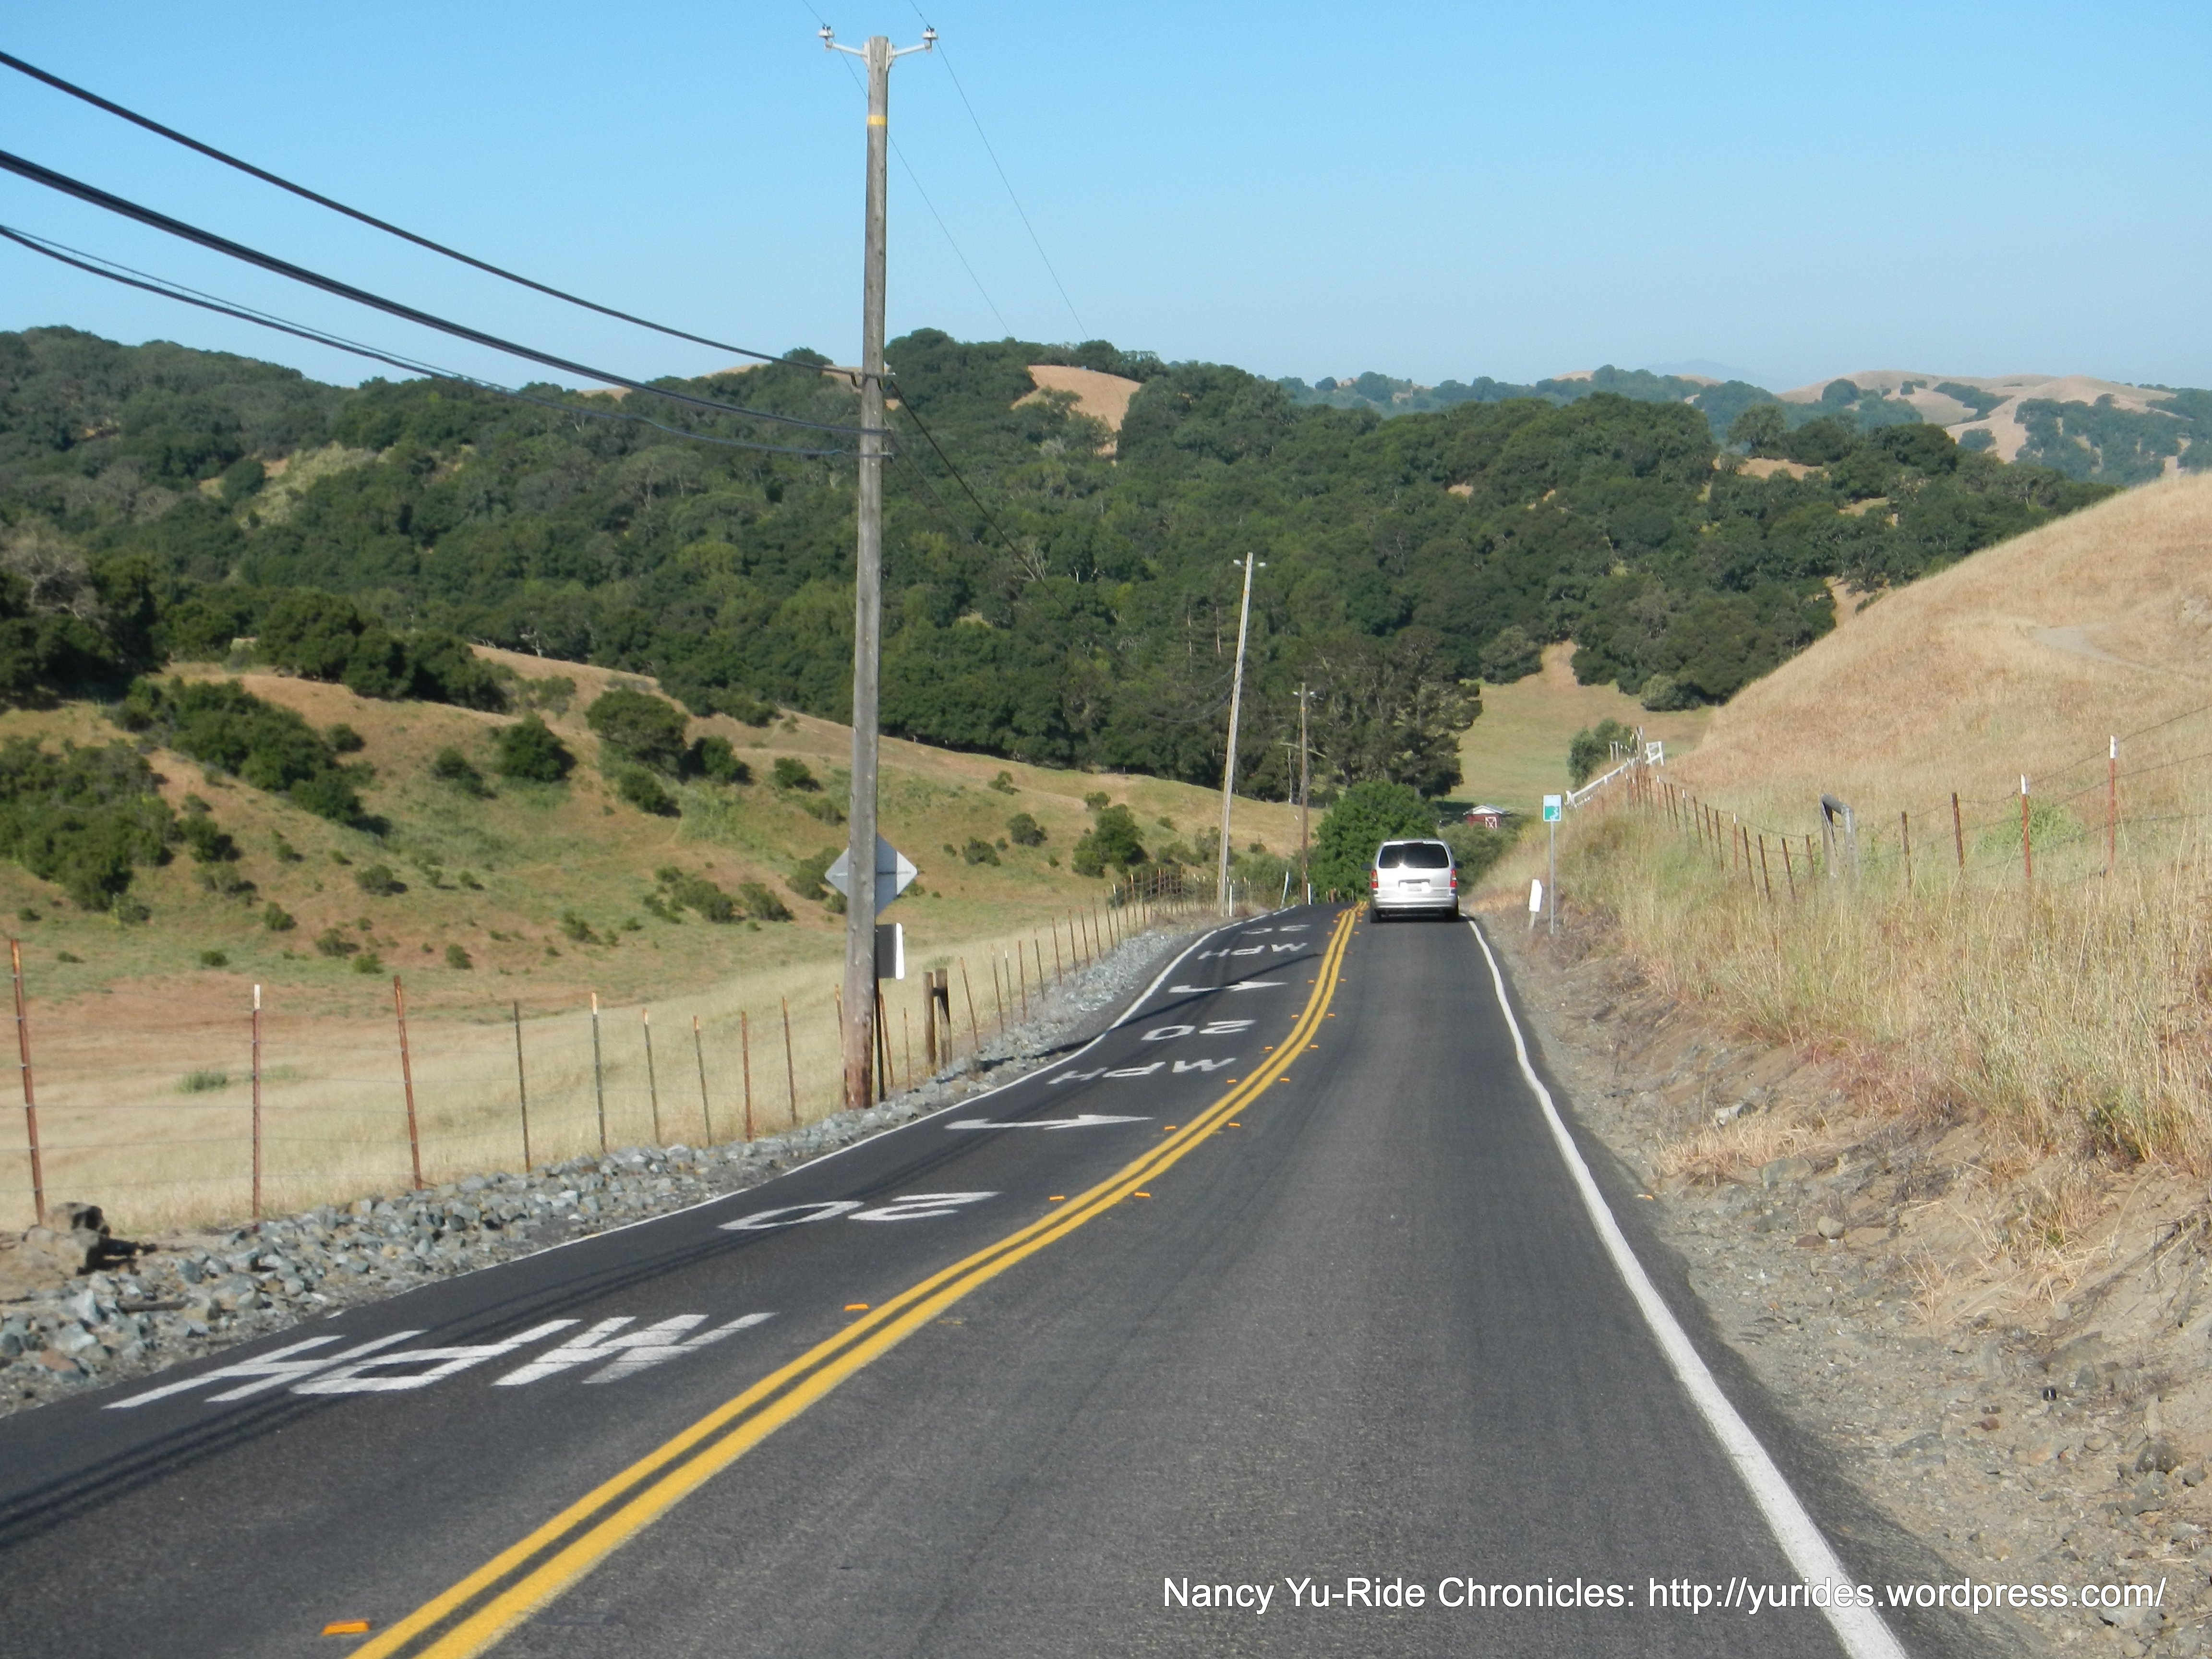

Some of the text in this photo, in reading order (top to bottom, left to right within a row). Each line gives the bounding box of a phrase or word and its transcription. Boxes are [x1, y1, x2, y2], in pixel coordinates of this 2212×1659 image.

[1197, 942, 1308, 960] MPH
[1141, 1019, 1256, 1041] 20
[1047, 1058, 1237, 1085] MPH
[717, 1191, 1001, 1230] 20
[101, 1312, 777, 1409] MPH
